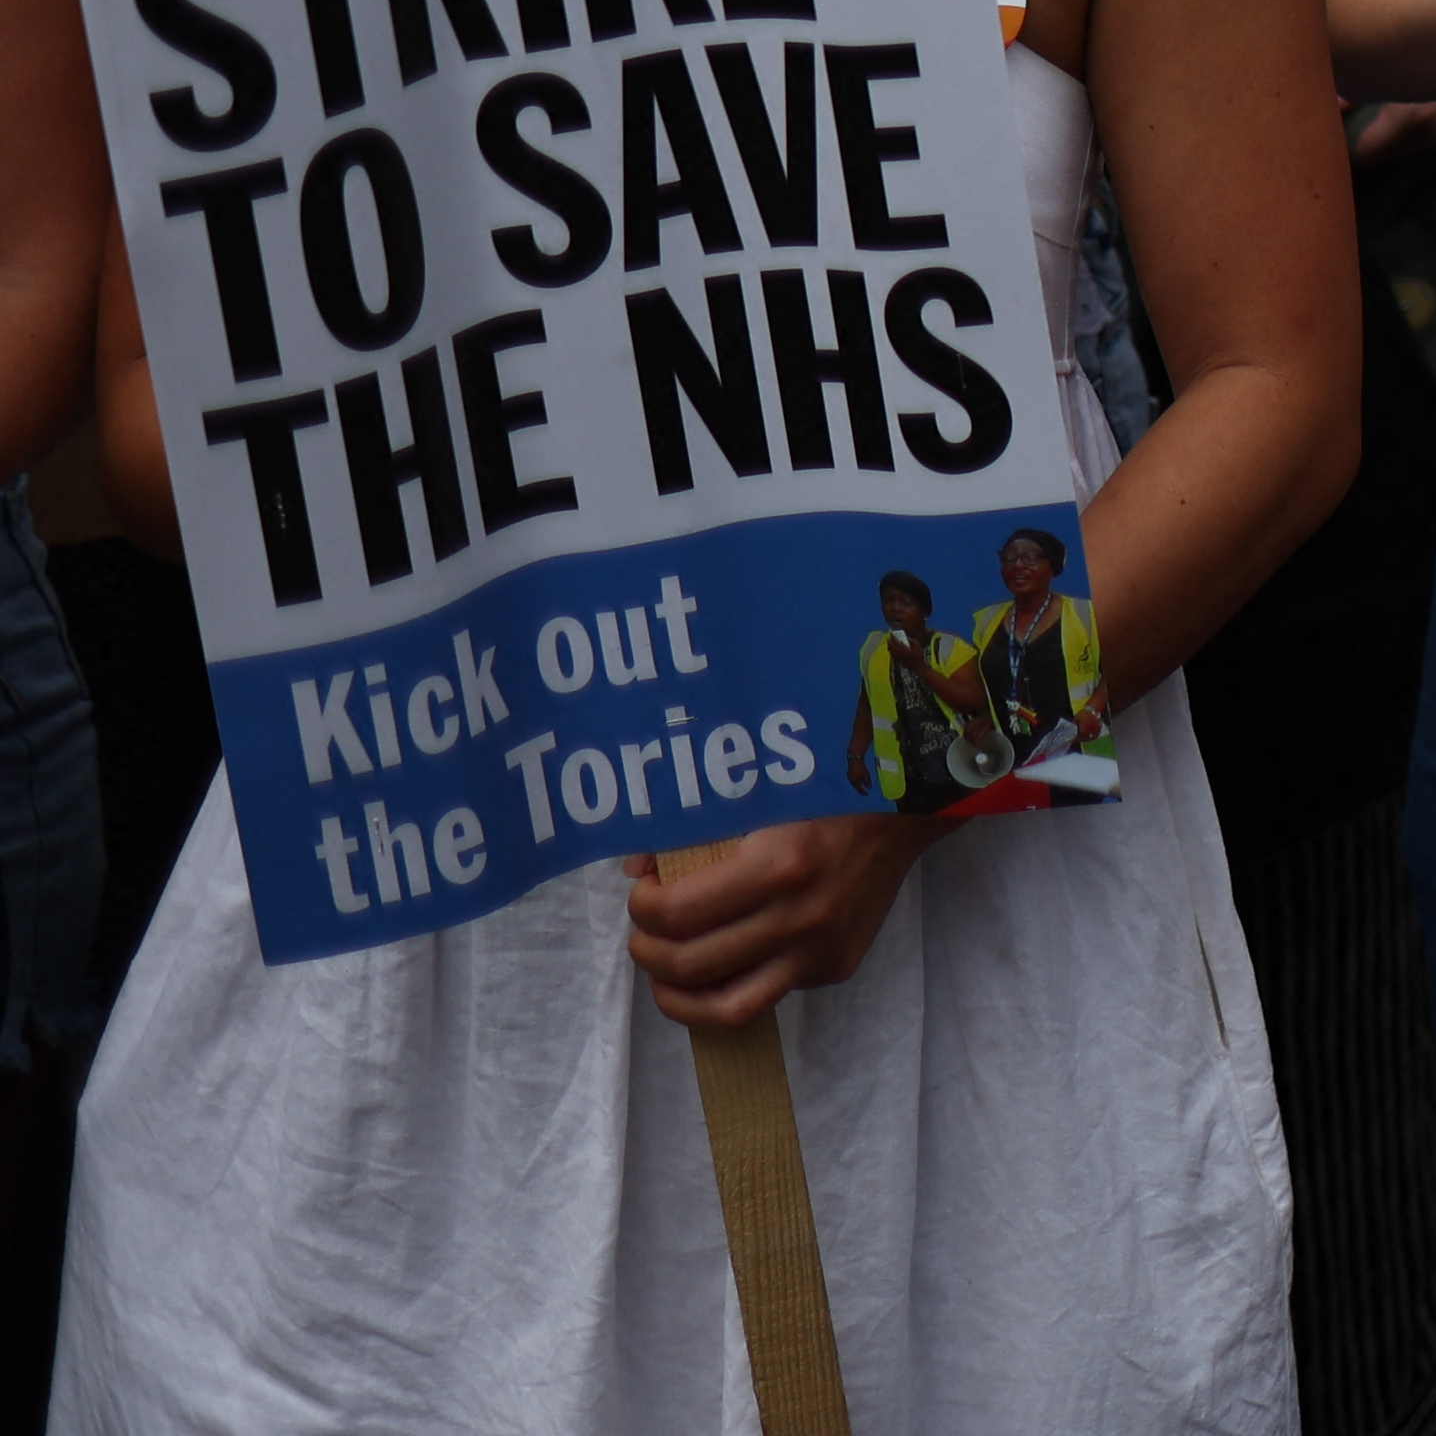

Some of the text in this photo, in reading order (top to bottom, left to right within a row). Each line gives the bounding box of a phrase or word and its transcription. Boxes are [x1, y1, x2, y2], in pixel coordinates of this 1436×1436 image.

[160, 42, 949, 384] TO SAVE
[202, 267, 1012, 608] THE NHS
[291, 574, 709, 785] Kick out
[315, 707, 817, 915] the Tories
